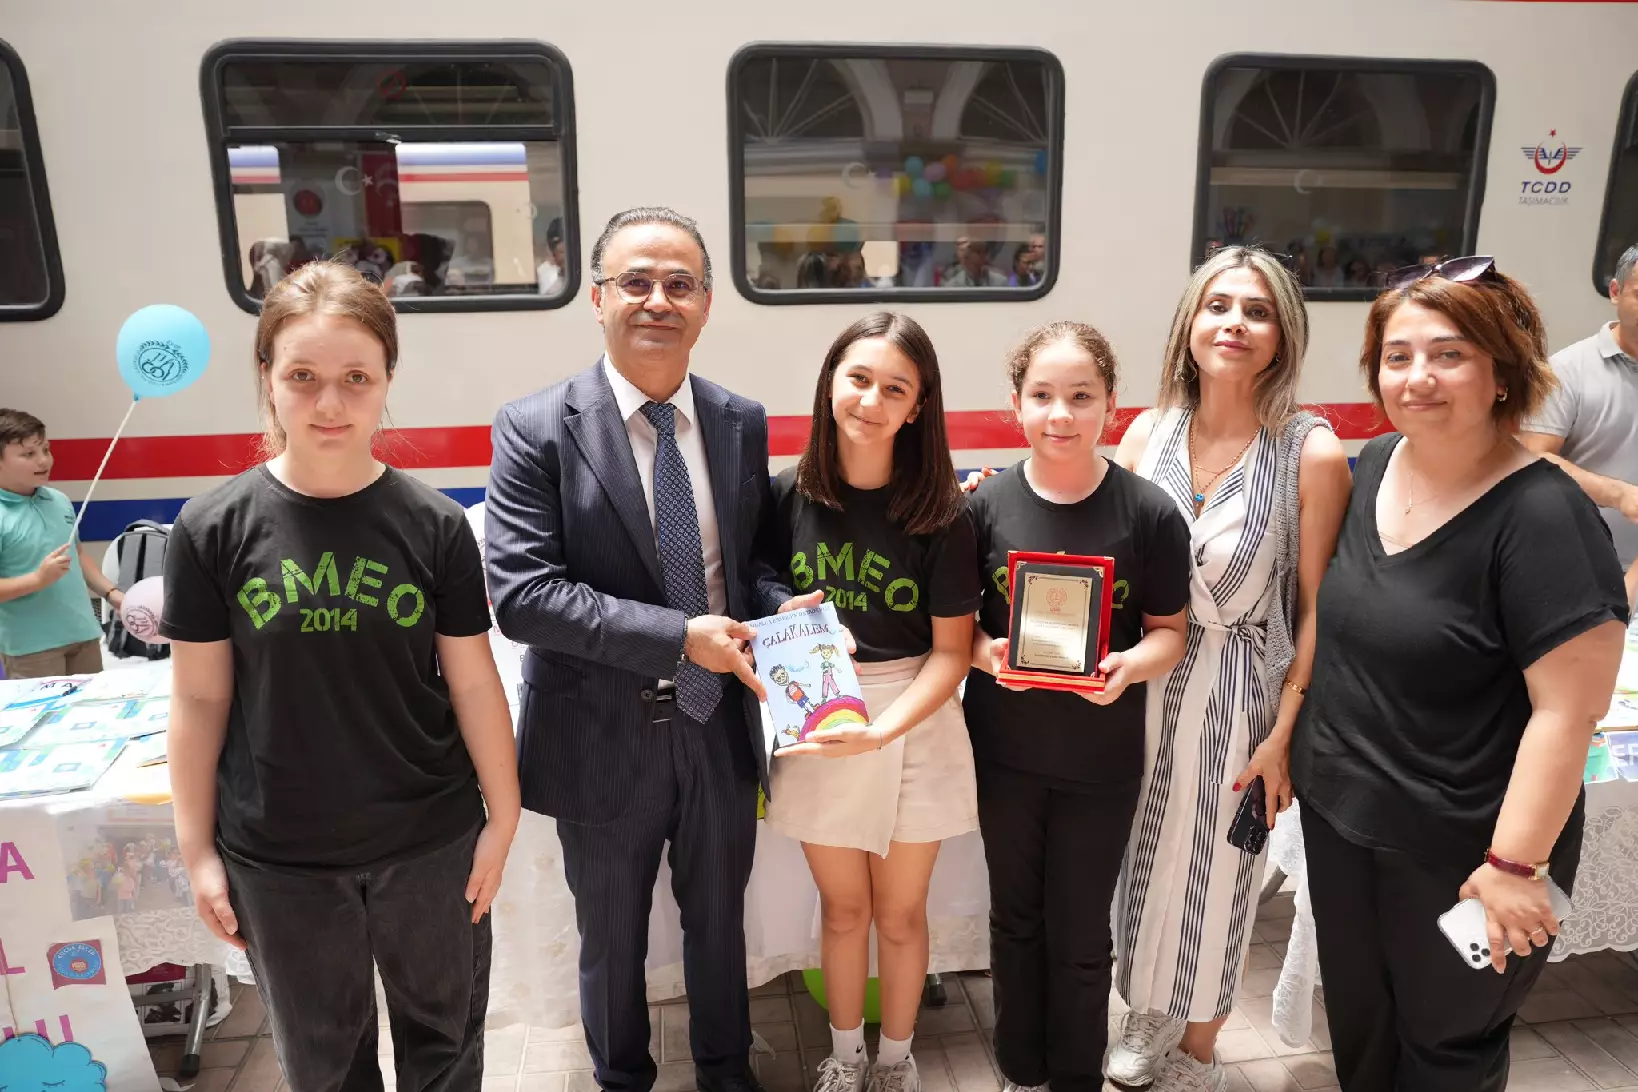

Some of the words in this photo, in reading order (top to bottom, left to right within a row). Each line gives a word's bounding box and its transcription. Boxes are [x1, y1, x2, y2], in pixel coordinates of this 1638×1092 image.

[1521, 181, 1572, 193] TCDD
[236, 551, 425, 629] BMEO
[790, 542, 919, 612] BMEO
[300, 607, 358, 632] 2014
